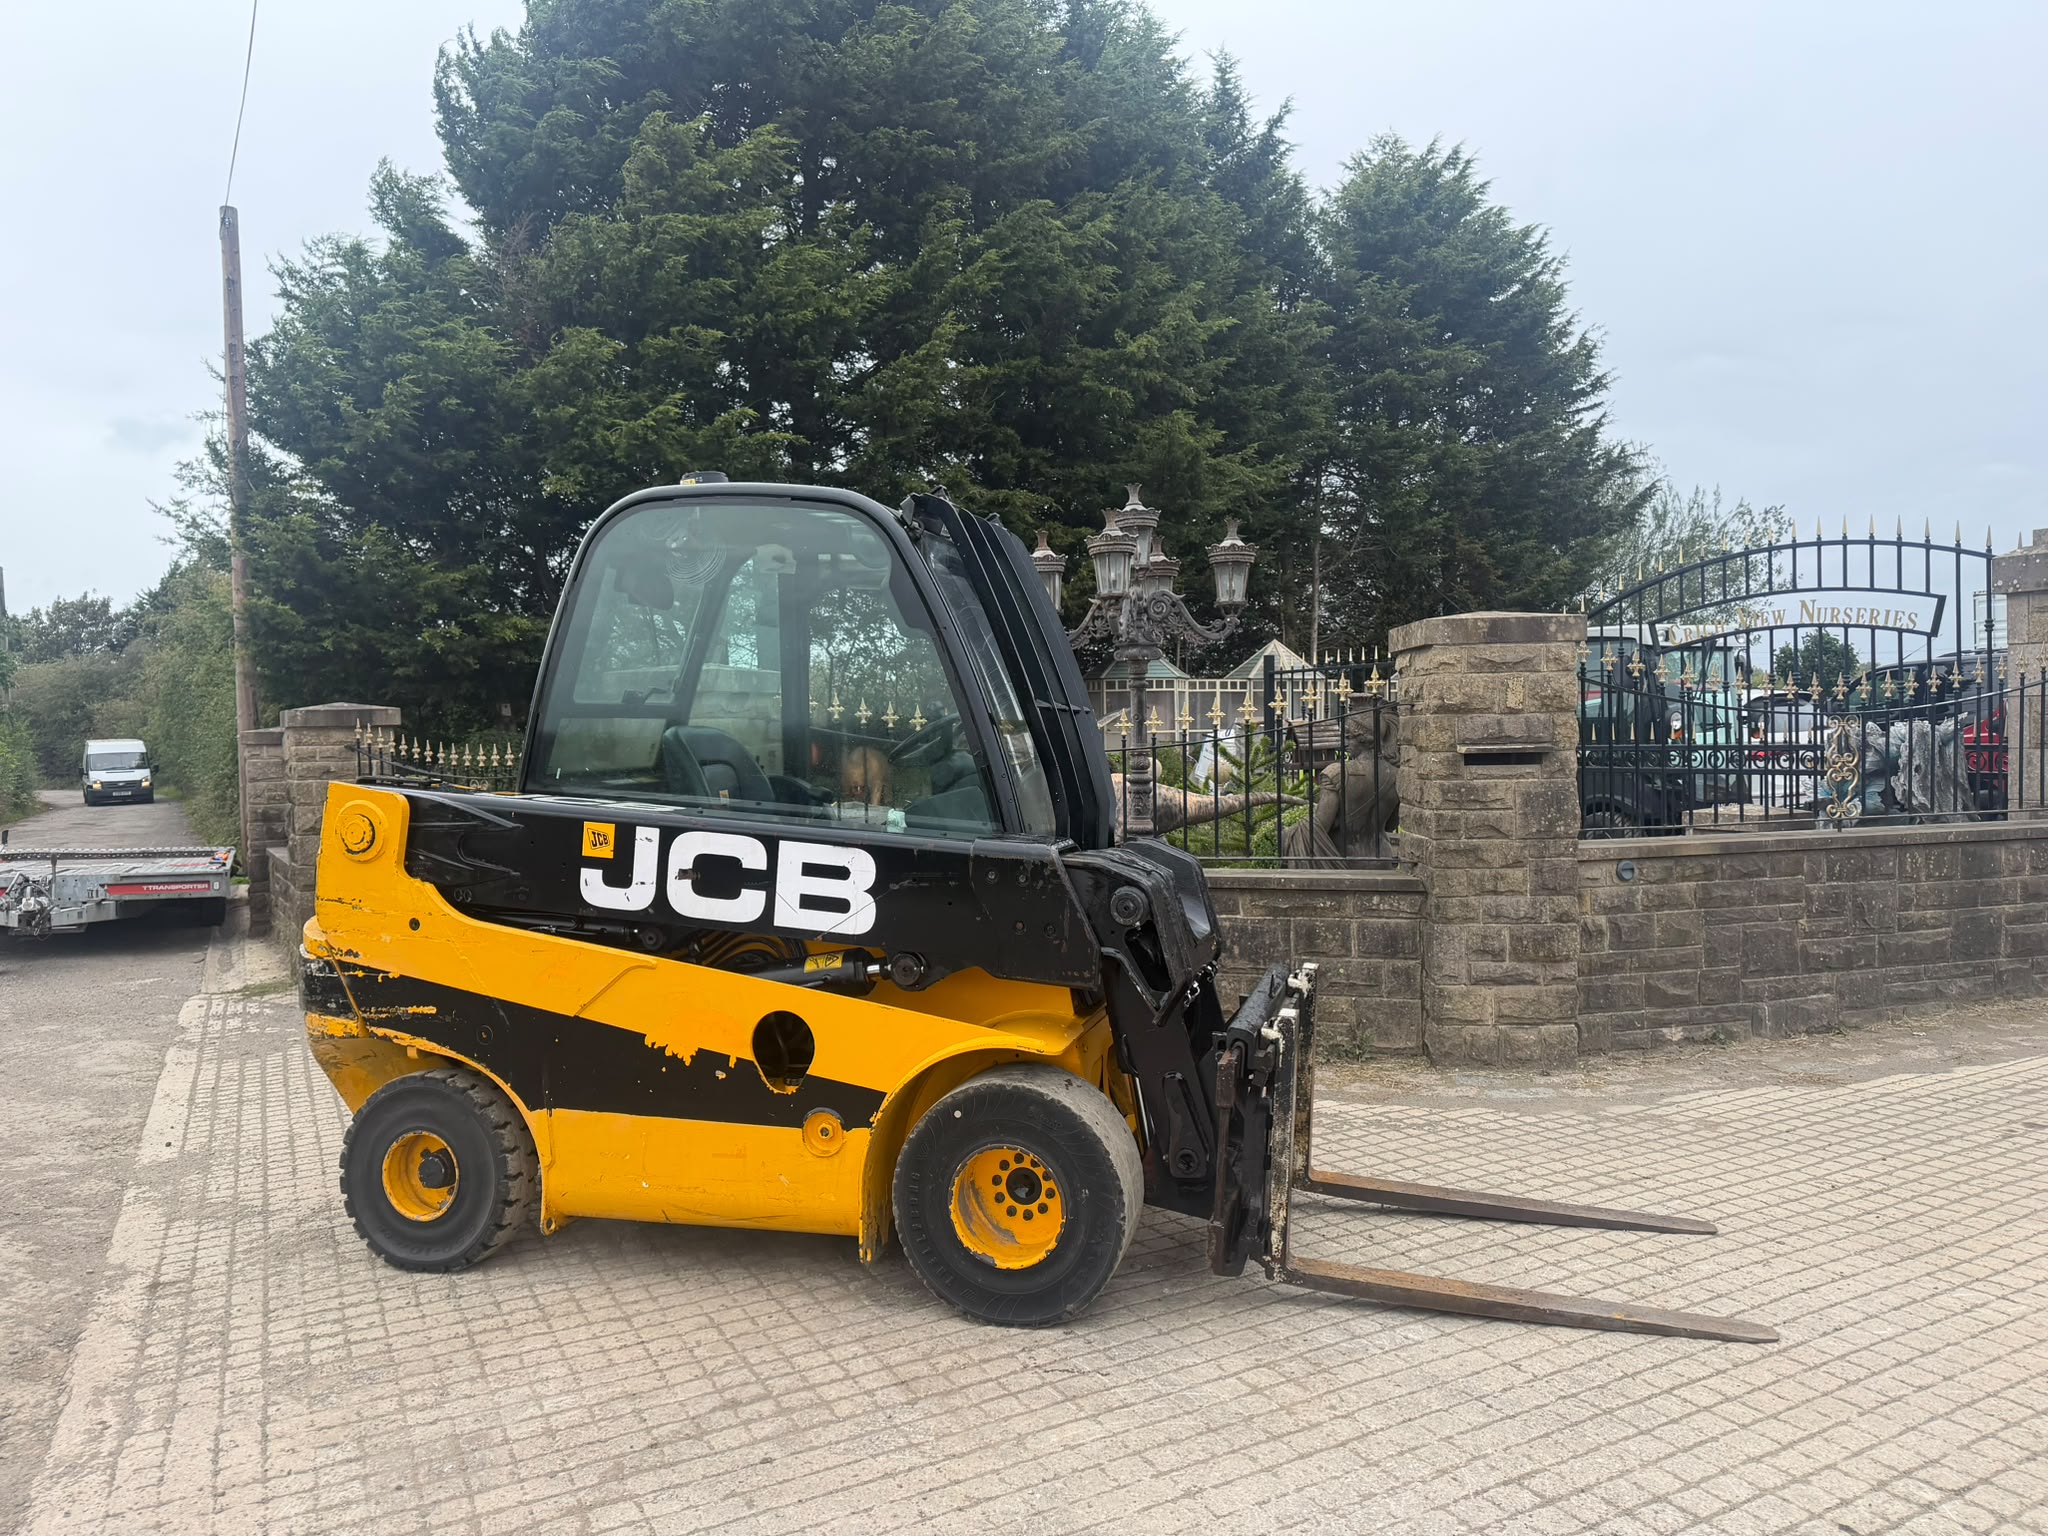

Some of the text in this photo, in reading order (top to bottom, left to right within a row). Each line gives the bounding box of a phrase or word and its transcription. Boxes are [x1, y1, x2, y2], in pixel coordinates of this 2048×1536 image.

[1736, 607, 1786, 630] VIEW
[1799, 599, 1918, 630] NURSERIES
[591, 831, 609, 848] JCB
[580, 826, 876, 935] JCB
